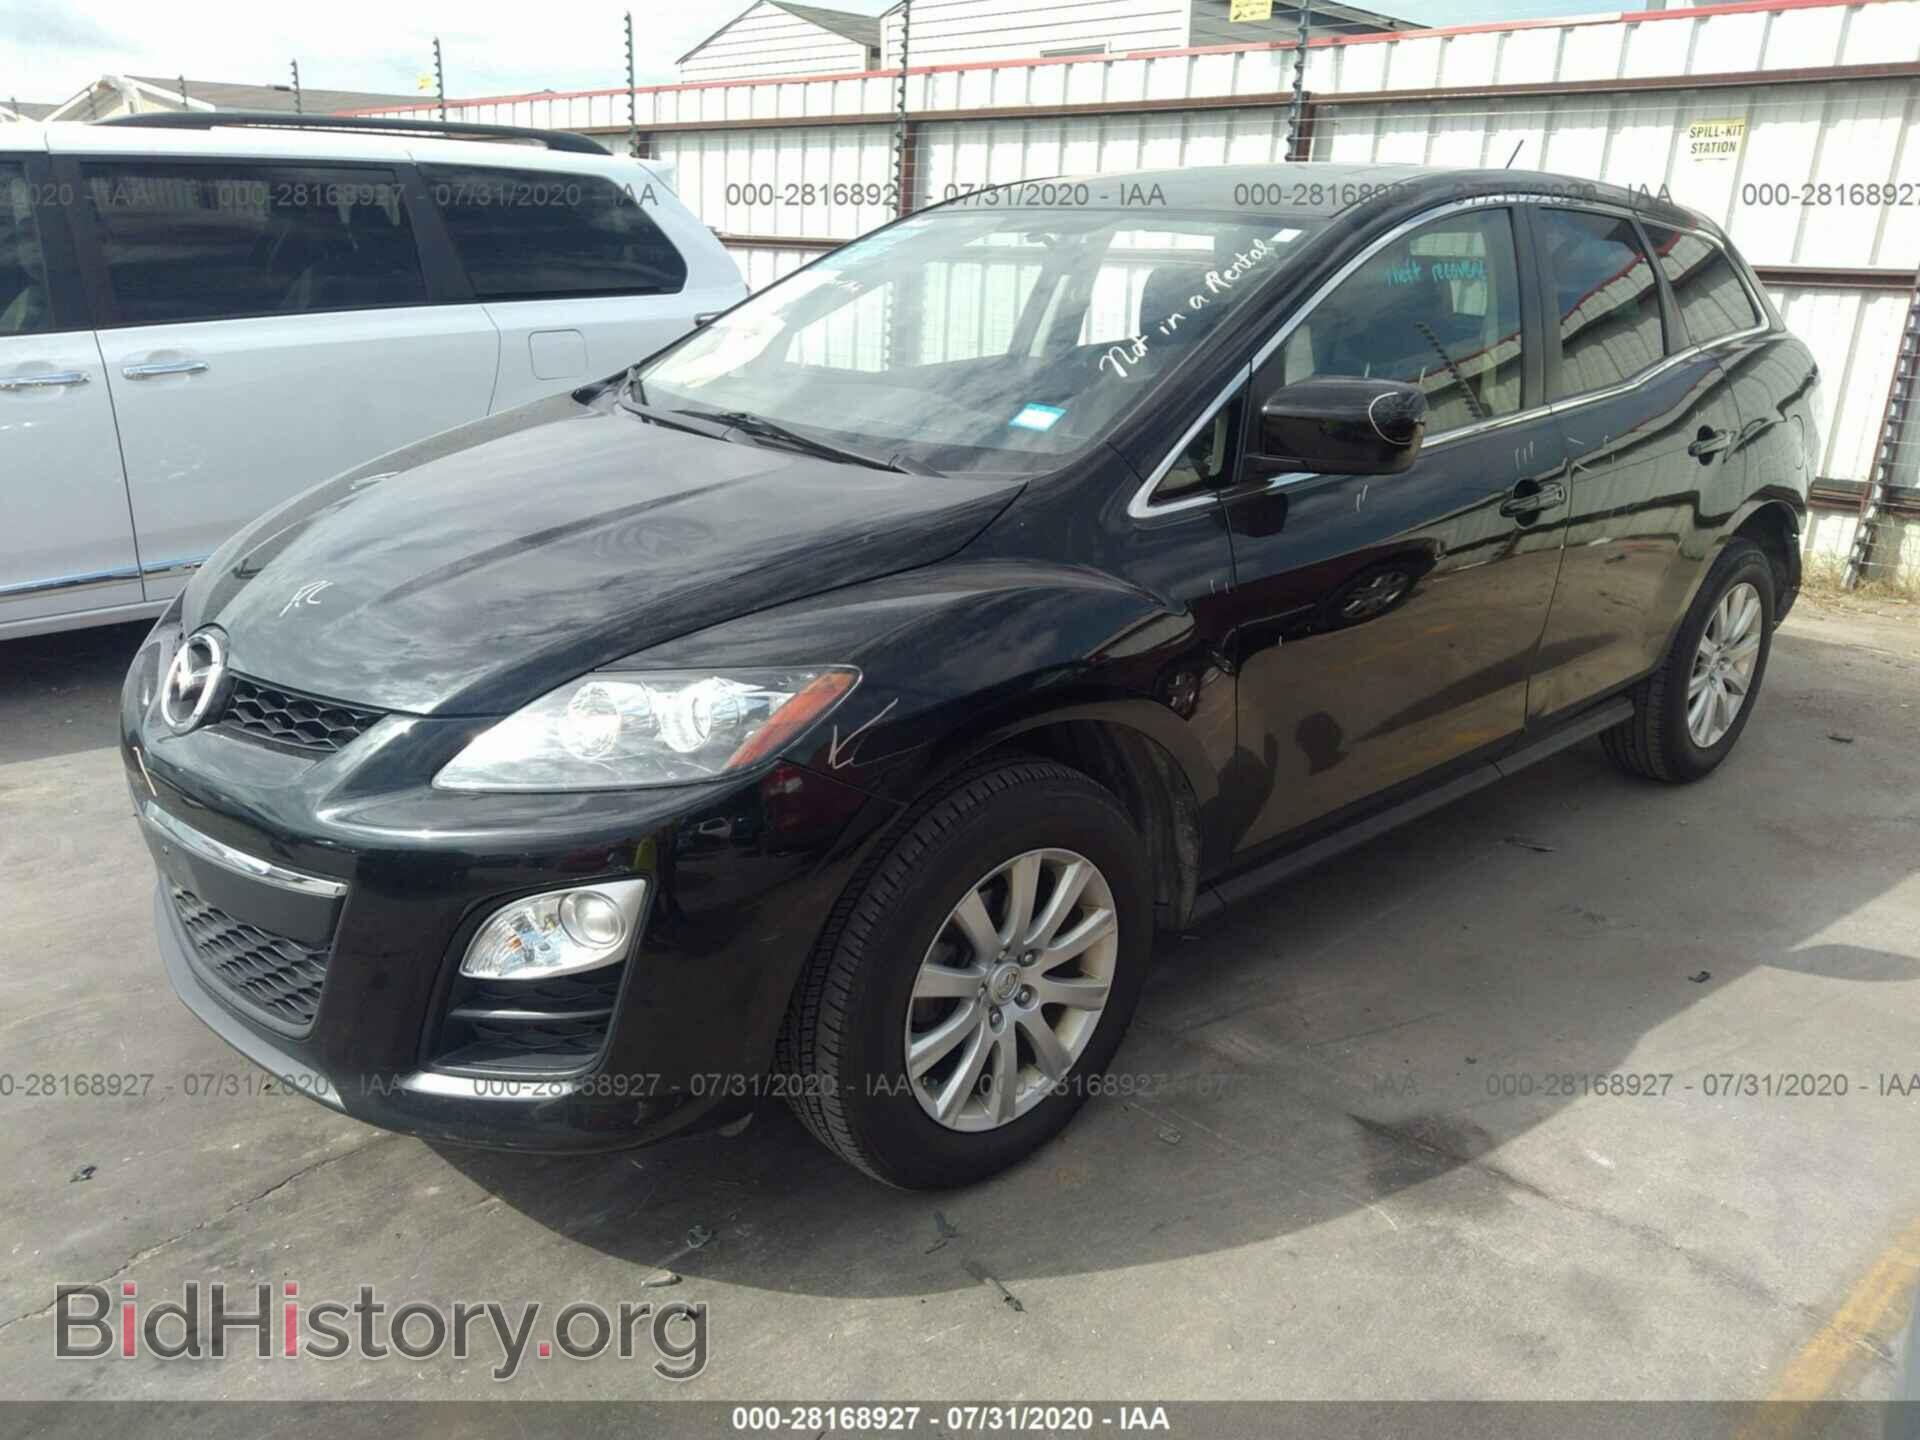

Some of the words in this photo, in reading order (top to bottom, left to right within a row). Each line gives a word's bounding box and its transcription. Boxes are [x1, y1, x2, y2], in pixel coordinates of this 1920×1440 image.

[1689, 124, 1744, 138] SPILL-KIT
[1690, 141, 1736, 154] STATION
[1159, 312, 1187, 336] in
[1189, 294, 1210, 310] a
[1205, 239, 1275, 294] Rental
